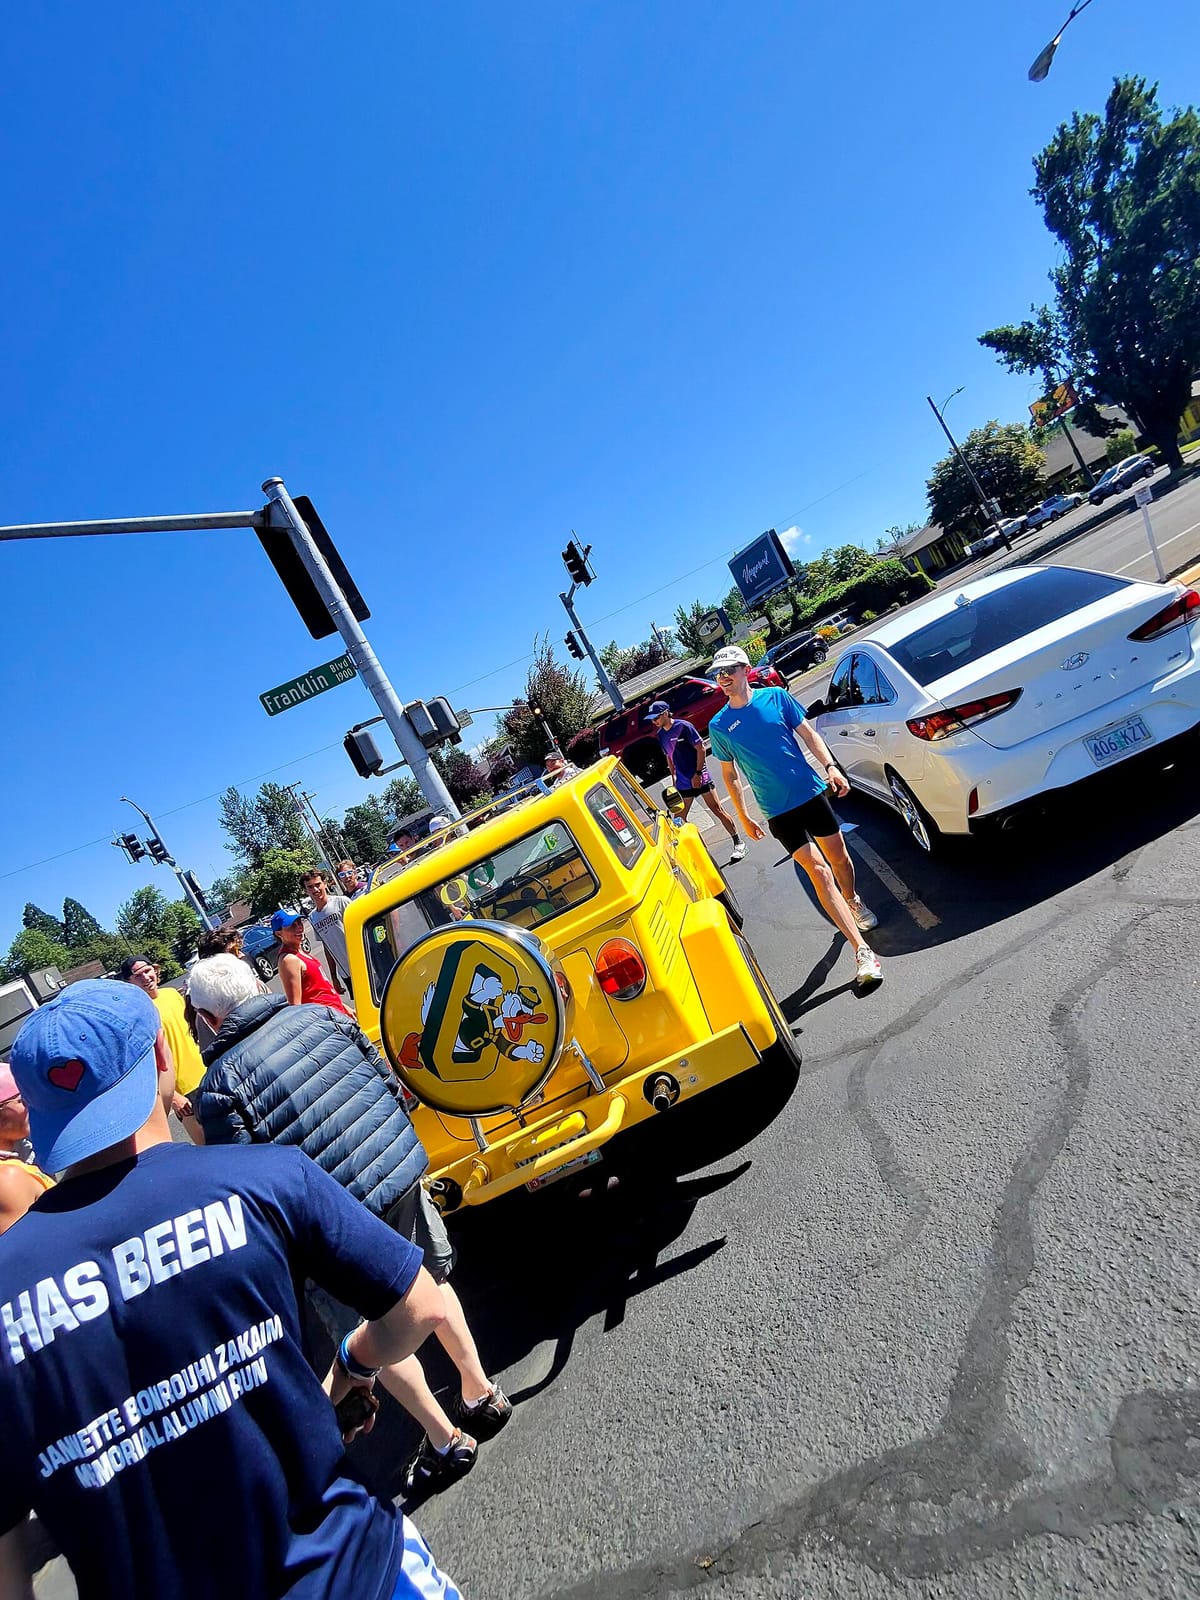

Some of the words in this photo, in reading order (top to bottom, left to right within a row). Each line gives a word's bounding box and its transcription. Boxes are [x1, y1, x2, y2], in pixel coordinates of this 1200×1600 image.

[263, 674, 329, 713] Franklin
[329, 658, 349, 673] Blvd
[335, 668, 354, 682] 1900
[1093, 736, 1118, 757] 406
[1120, 722, 1146, 745] KZT
[0, 1260, 110, 1365] HAS
[112, 1194, 248, 1301] BEEN
[214, 1314, 284, 1373] ZAKAIM
[74, 1421, 166, 1489] MMORIAL
[160, 1381, 232, 1443] ALUMNI
[227, 1356, 268, 1400] RUN
